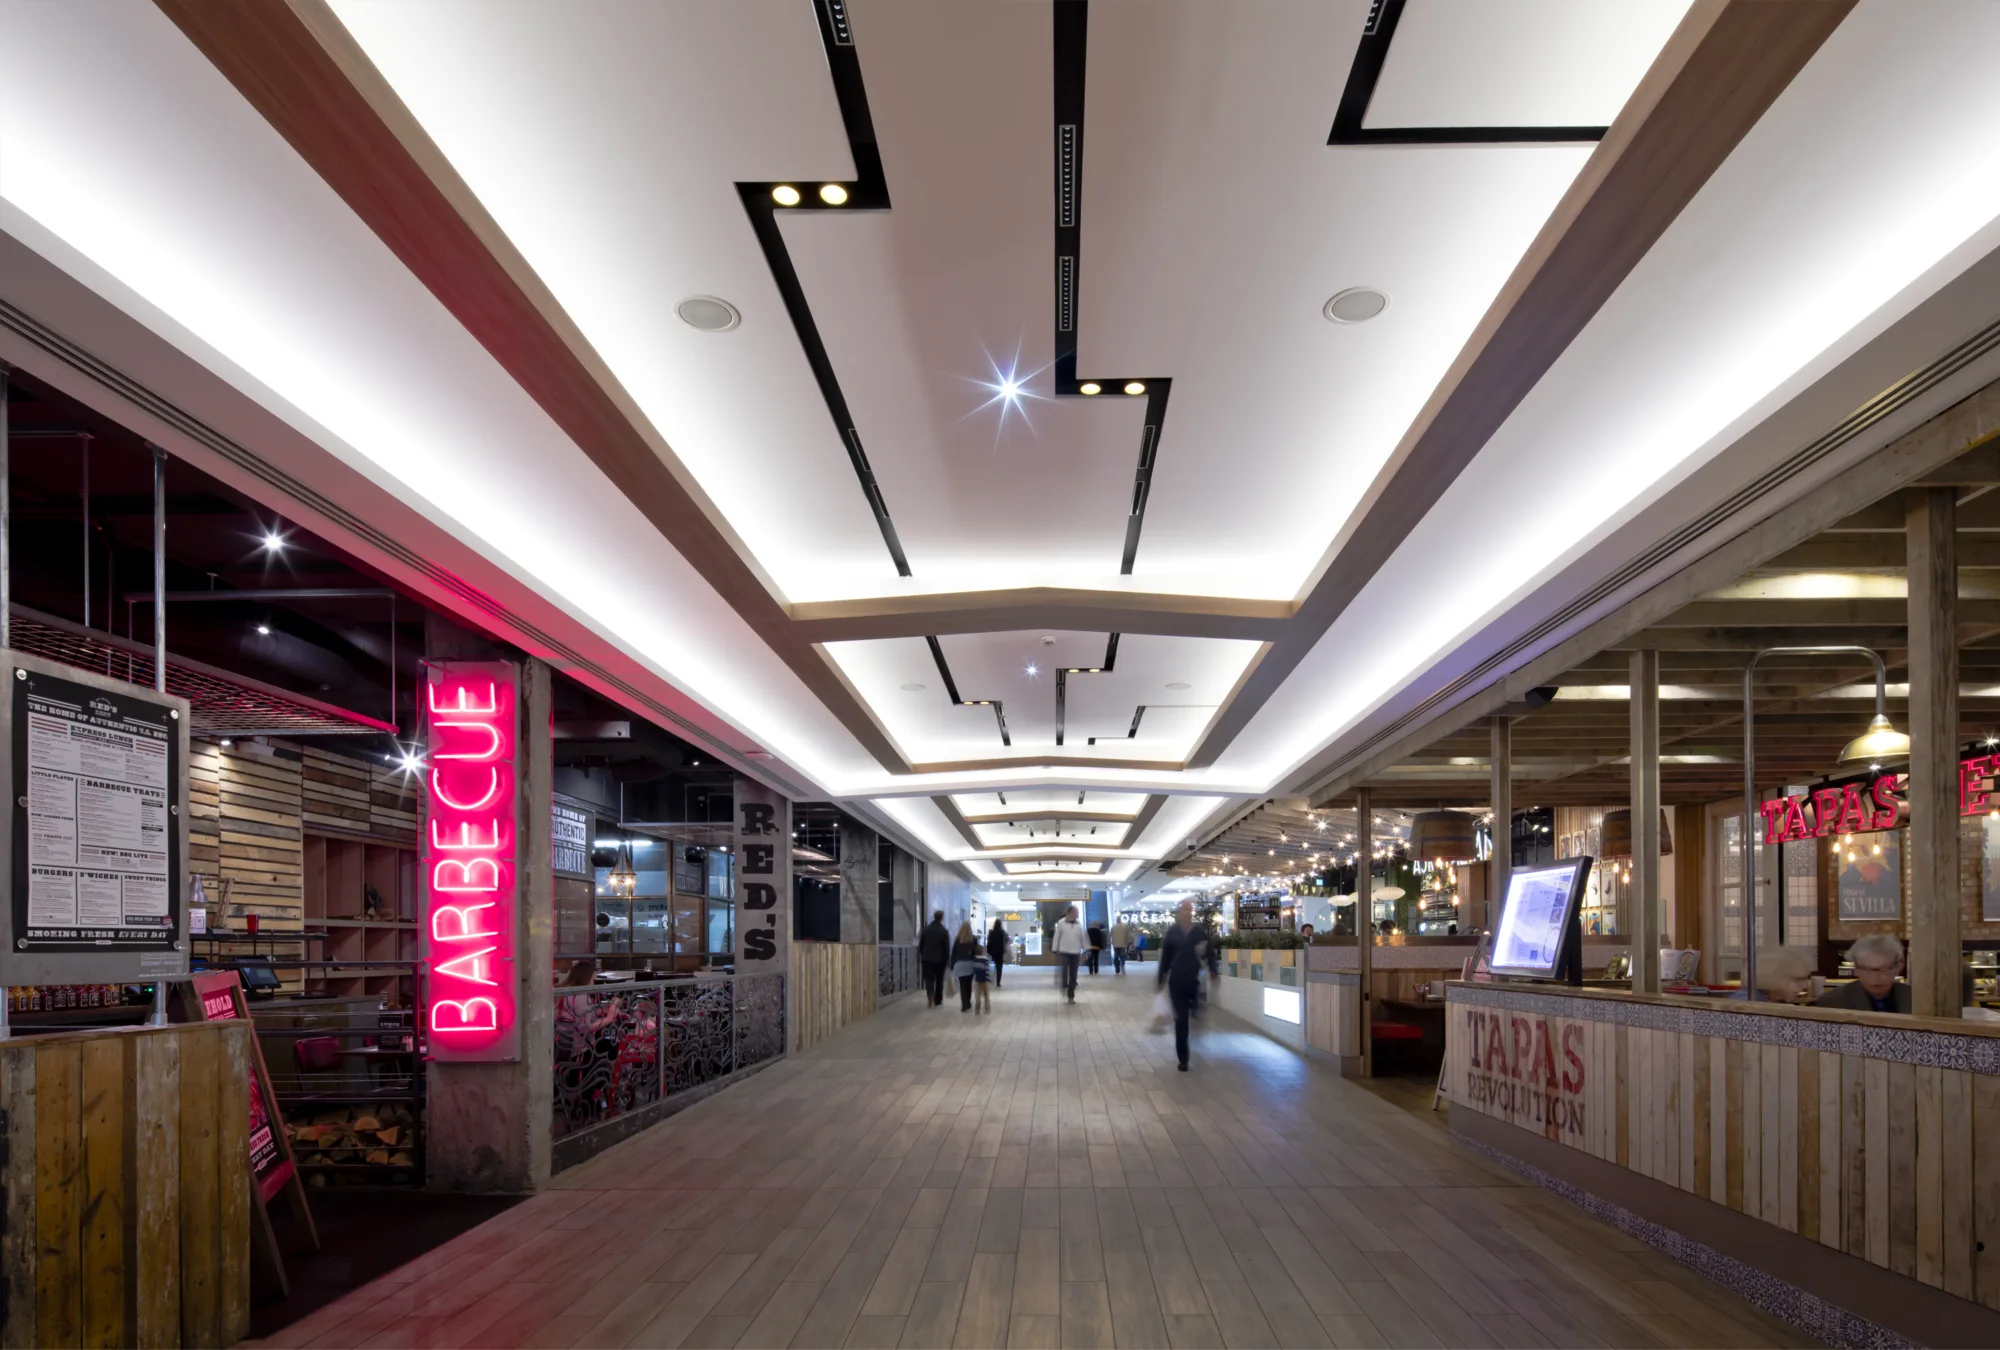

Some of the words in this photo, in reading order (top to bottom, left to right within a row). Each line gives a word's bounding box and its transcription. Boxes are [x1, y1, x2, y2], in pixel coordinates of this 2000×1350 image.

[70, 725, 107, 738] EXPRESS
[108, 732, 133, 743] LUNCH
[87, 780, 131, 793] BARBECUE
[133, 787, 160, 798] TRAYS
[1761, 774, 1900, 844] TAPAS
[1959, 752, 2000, 816] E
[32, 867, 73, 877] BURGERS
[429, 682, 499, 1031] BARBECUE
[740, 802, 780, 961] RED'S
[27, 930, 78, 938] SMOKING
[80, 930, 115, 938] FRESH
[1467, 1011, 1585, 1095] TAPAS
[1467, 1071, 1585, 1137] REVOLUTION
